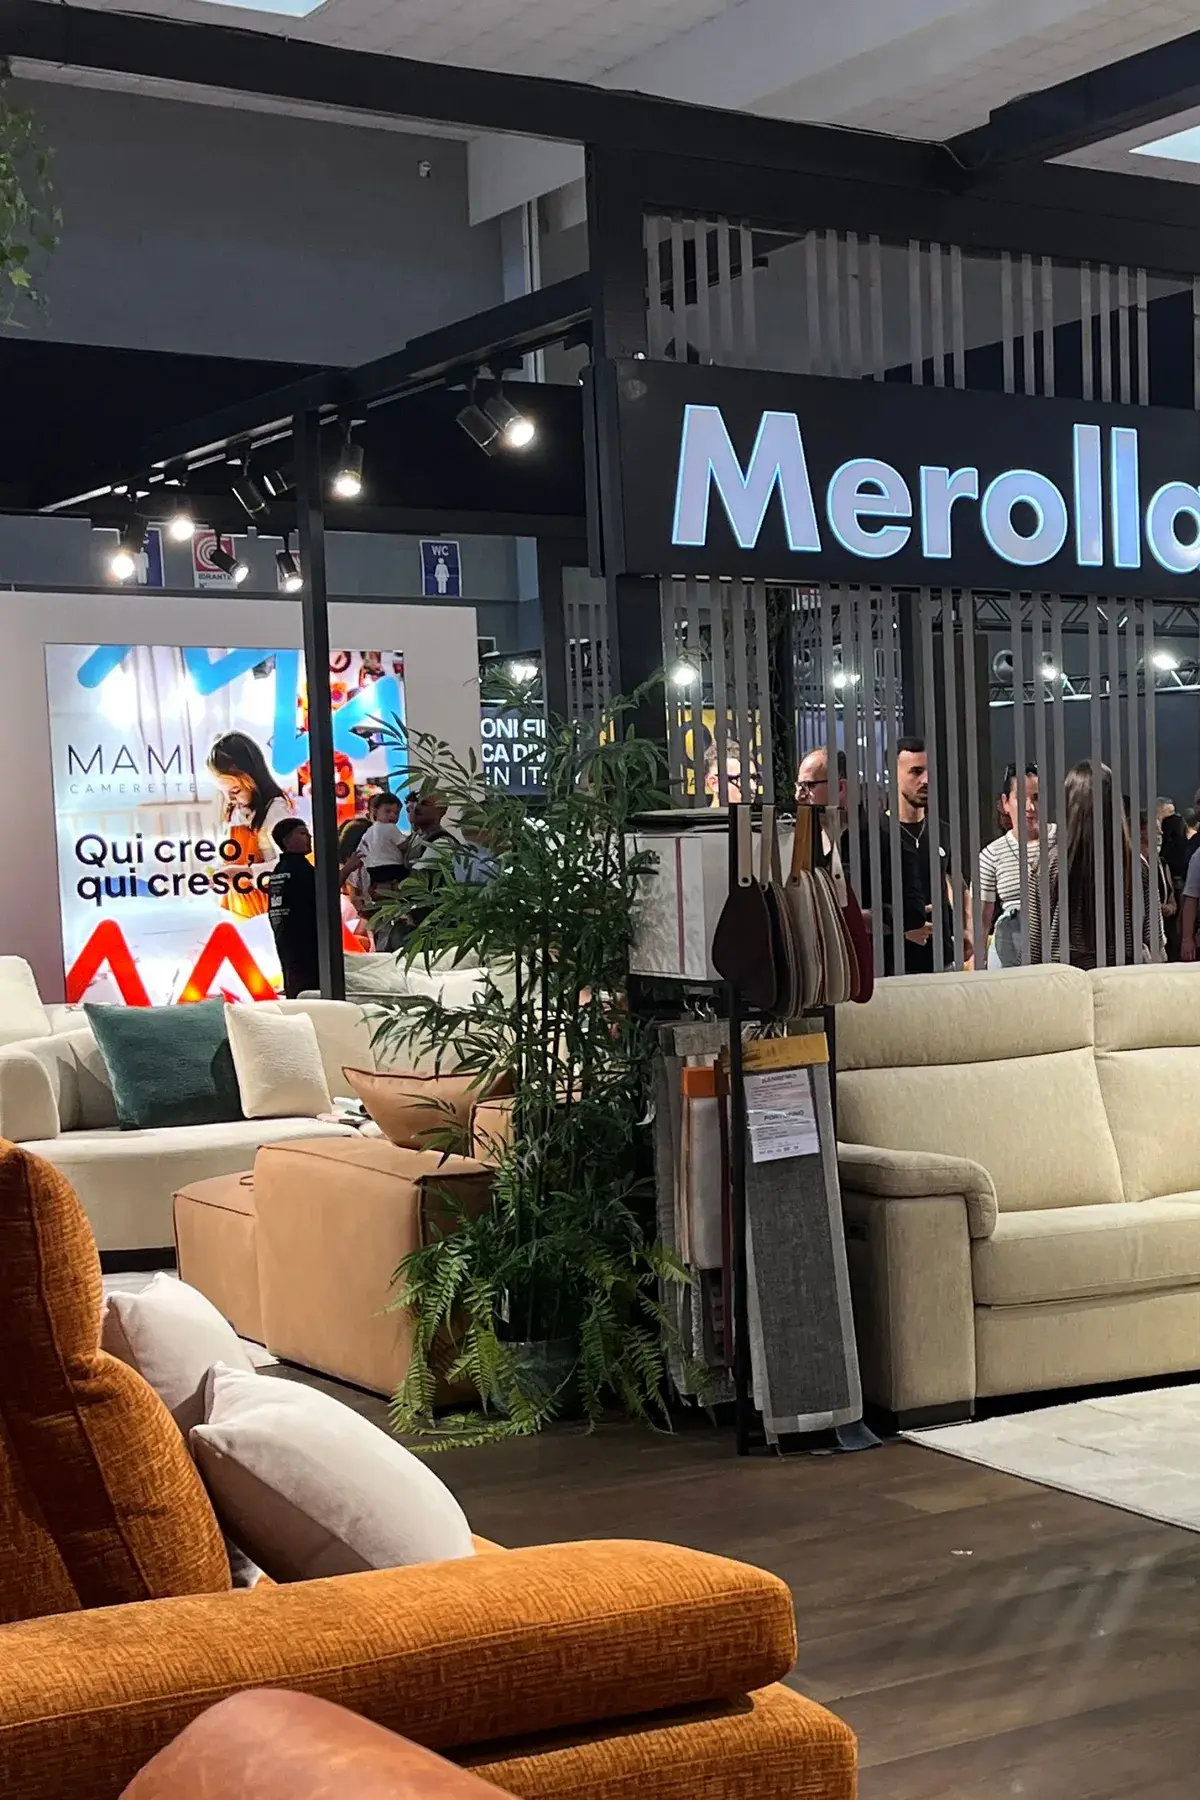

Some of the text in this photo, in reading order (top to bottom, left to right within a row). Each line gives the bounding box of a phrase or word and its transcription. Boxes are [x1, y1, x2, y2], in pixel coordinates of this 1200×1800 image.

[431, 545, 449, 556] WC
[67, 744, 195, 776] MAMI
[69, 783, 197, 795] CAMERETTE
[75, 832, 256, 868] Qui creo,
[76, 866, 137, 907] qui
